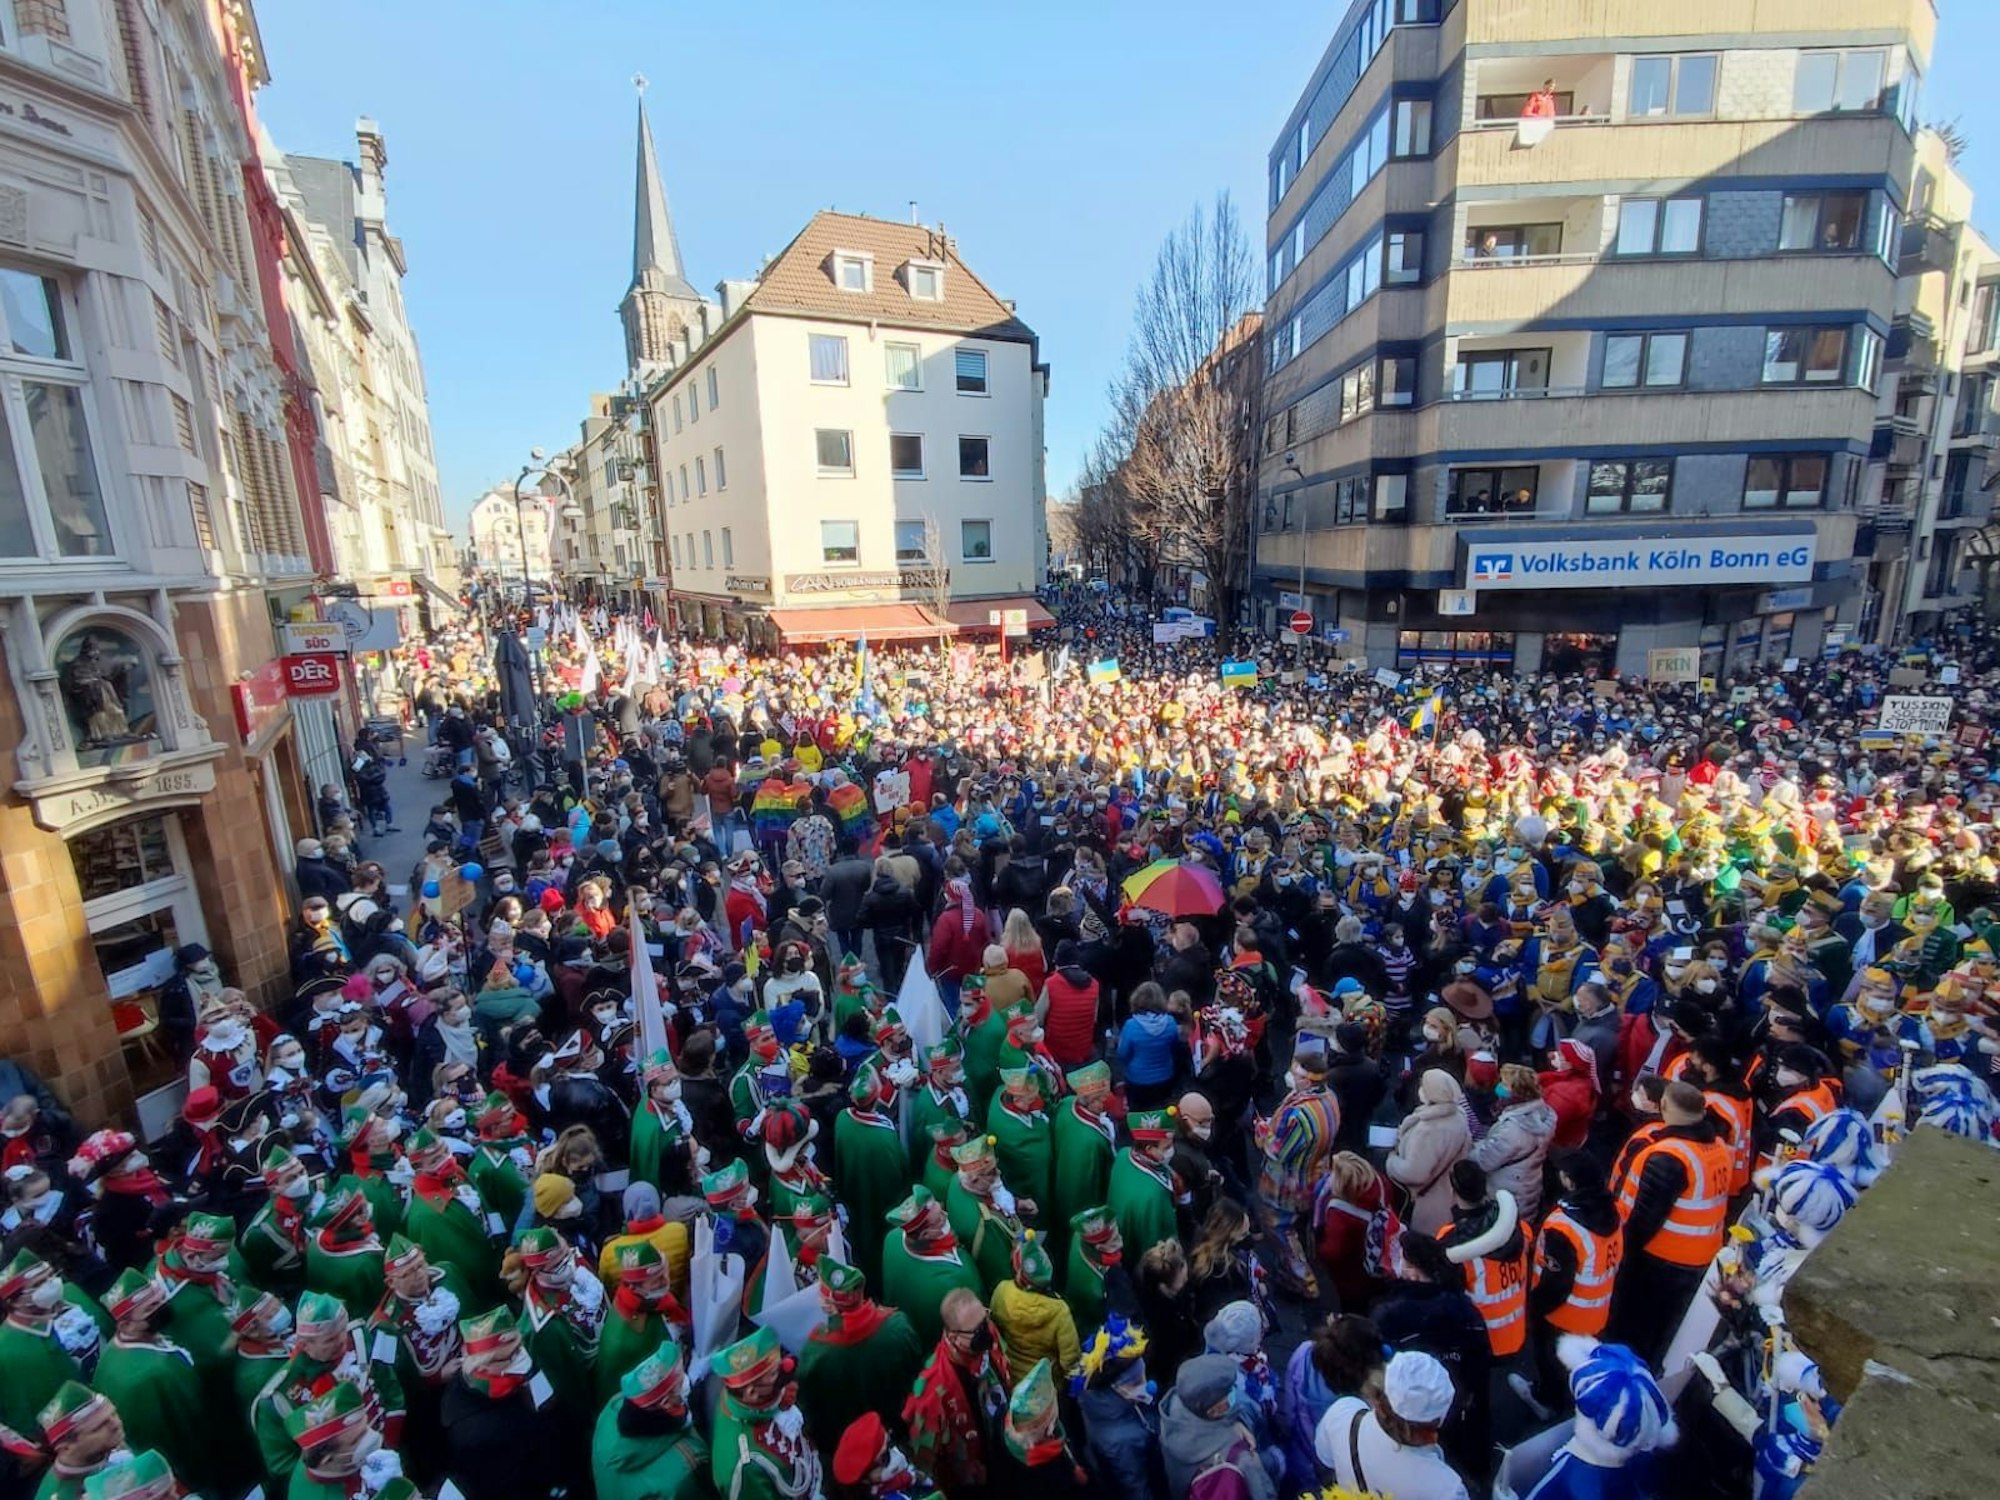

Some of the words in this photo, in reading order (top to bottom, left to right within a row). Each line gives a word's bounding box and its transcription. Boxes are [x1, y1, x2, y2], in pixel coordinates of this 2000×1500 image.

[1520, 552, 1640, 573] Volksbank
[1648, 549, 1701, 570] Köln
[1710, 549, 1769, 568] Bonn
[1777, 547, 1808, 567] eG
[304, 636, 331, 649] SÜD
[290, 659, 333, 681] DER
[1883, 718, 1917, 730] STOP
